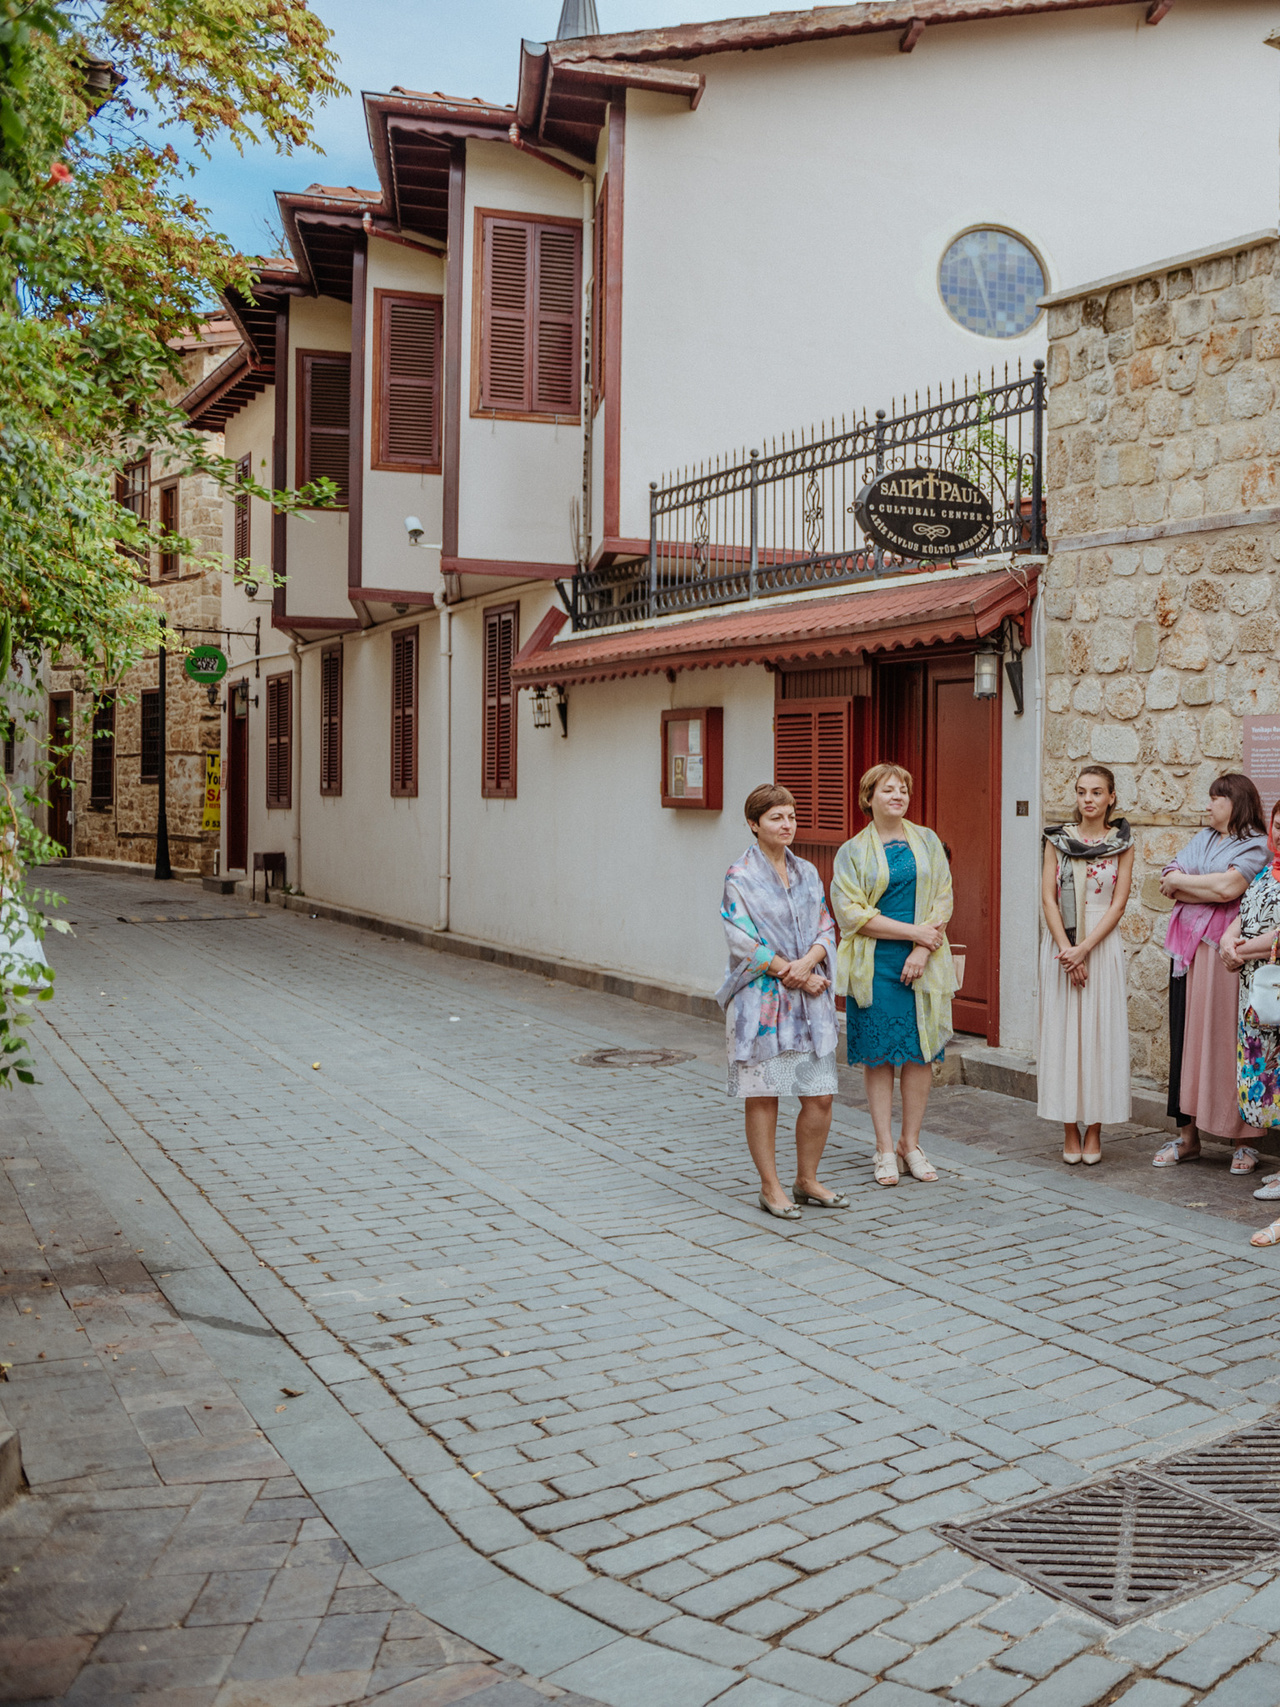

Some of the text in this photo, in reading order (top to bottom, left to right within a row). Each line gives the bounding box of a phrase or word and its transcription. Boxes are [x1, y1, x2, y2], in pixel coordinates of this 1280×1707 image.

[880, 472, 982, 504] SAINT PAUL
[879, 504, 983, 521] CULTURAL CENTER
[887, 530, 919, 551] PAVLUS
